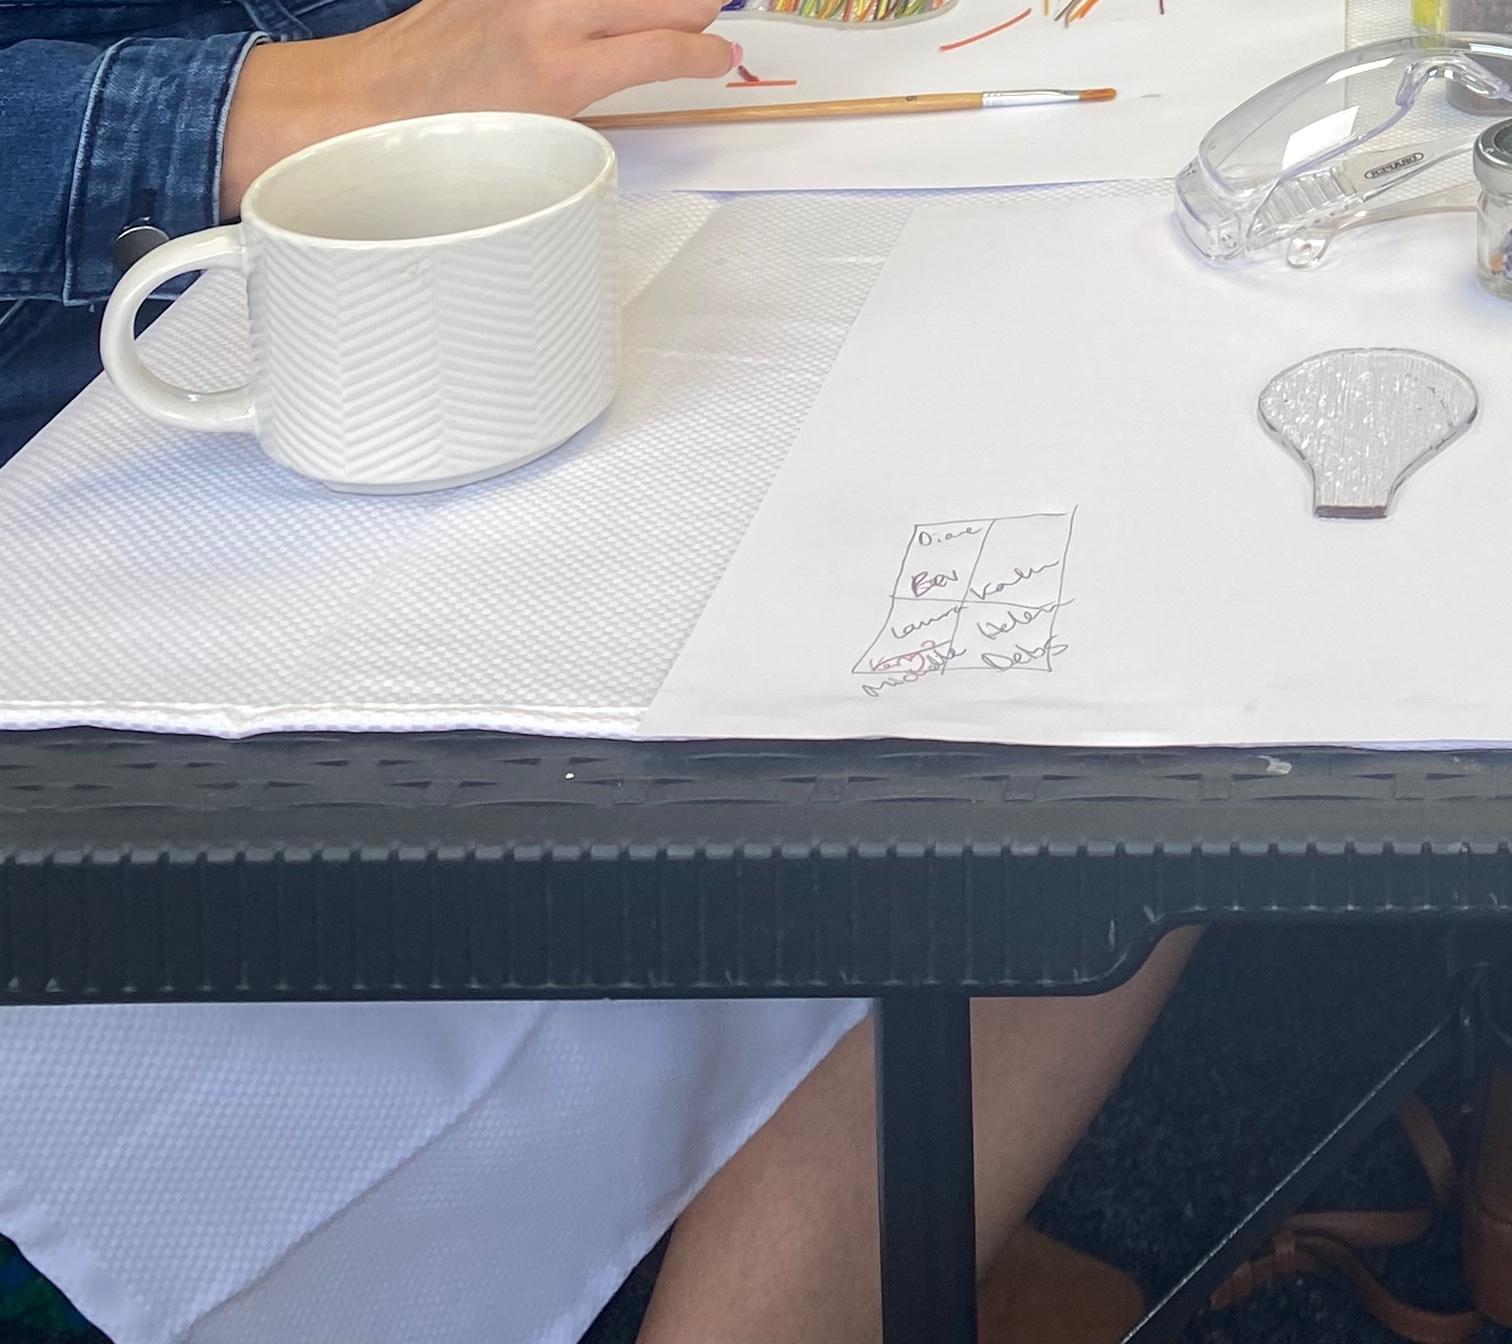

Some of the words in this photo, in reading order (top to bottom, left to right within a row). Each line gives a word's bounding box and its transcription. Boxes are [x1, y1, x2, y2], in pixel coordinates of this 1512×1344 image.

[919, 526, 983, 547] Diane
[911, 569, 959, 598] Bev
[981, 634, 1069, 672] Debs
